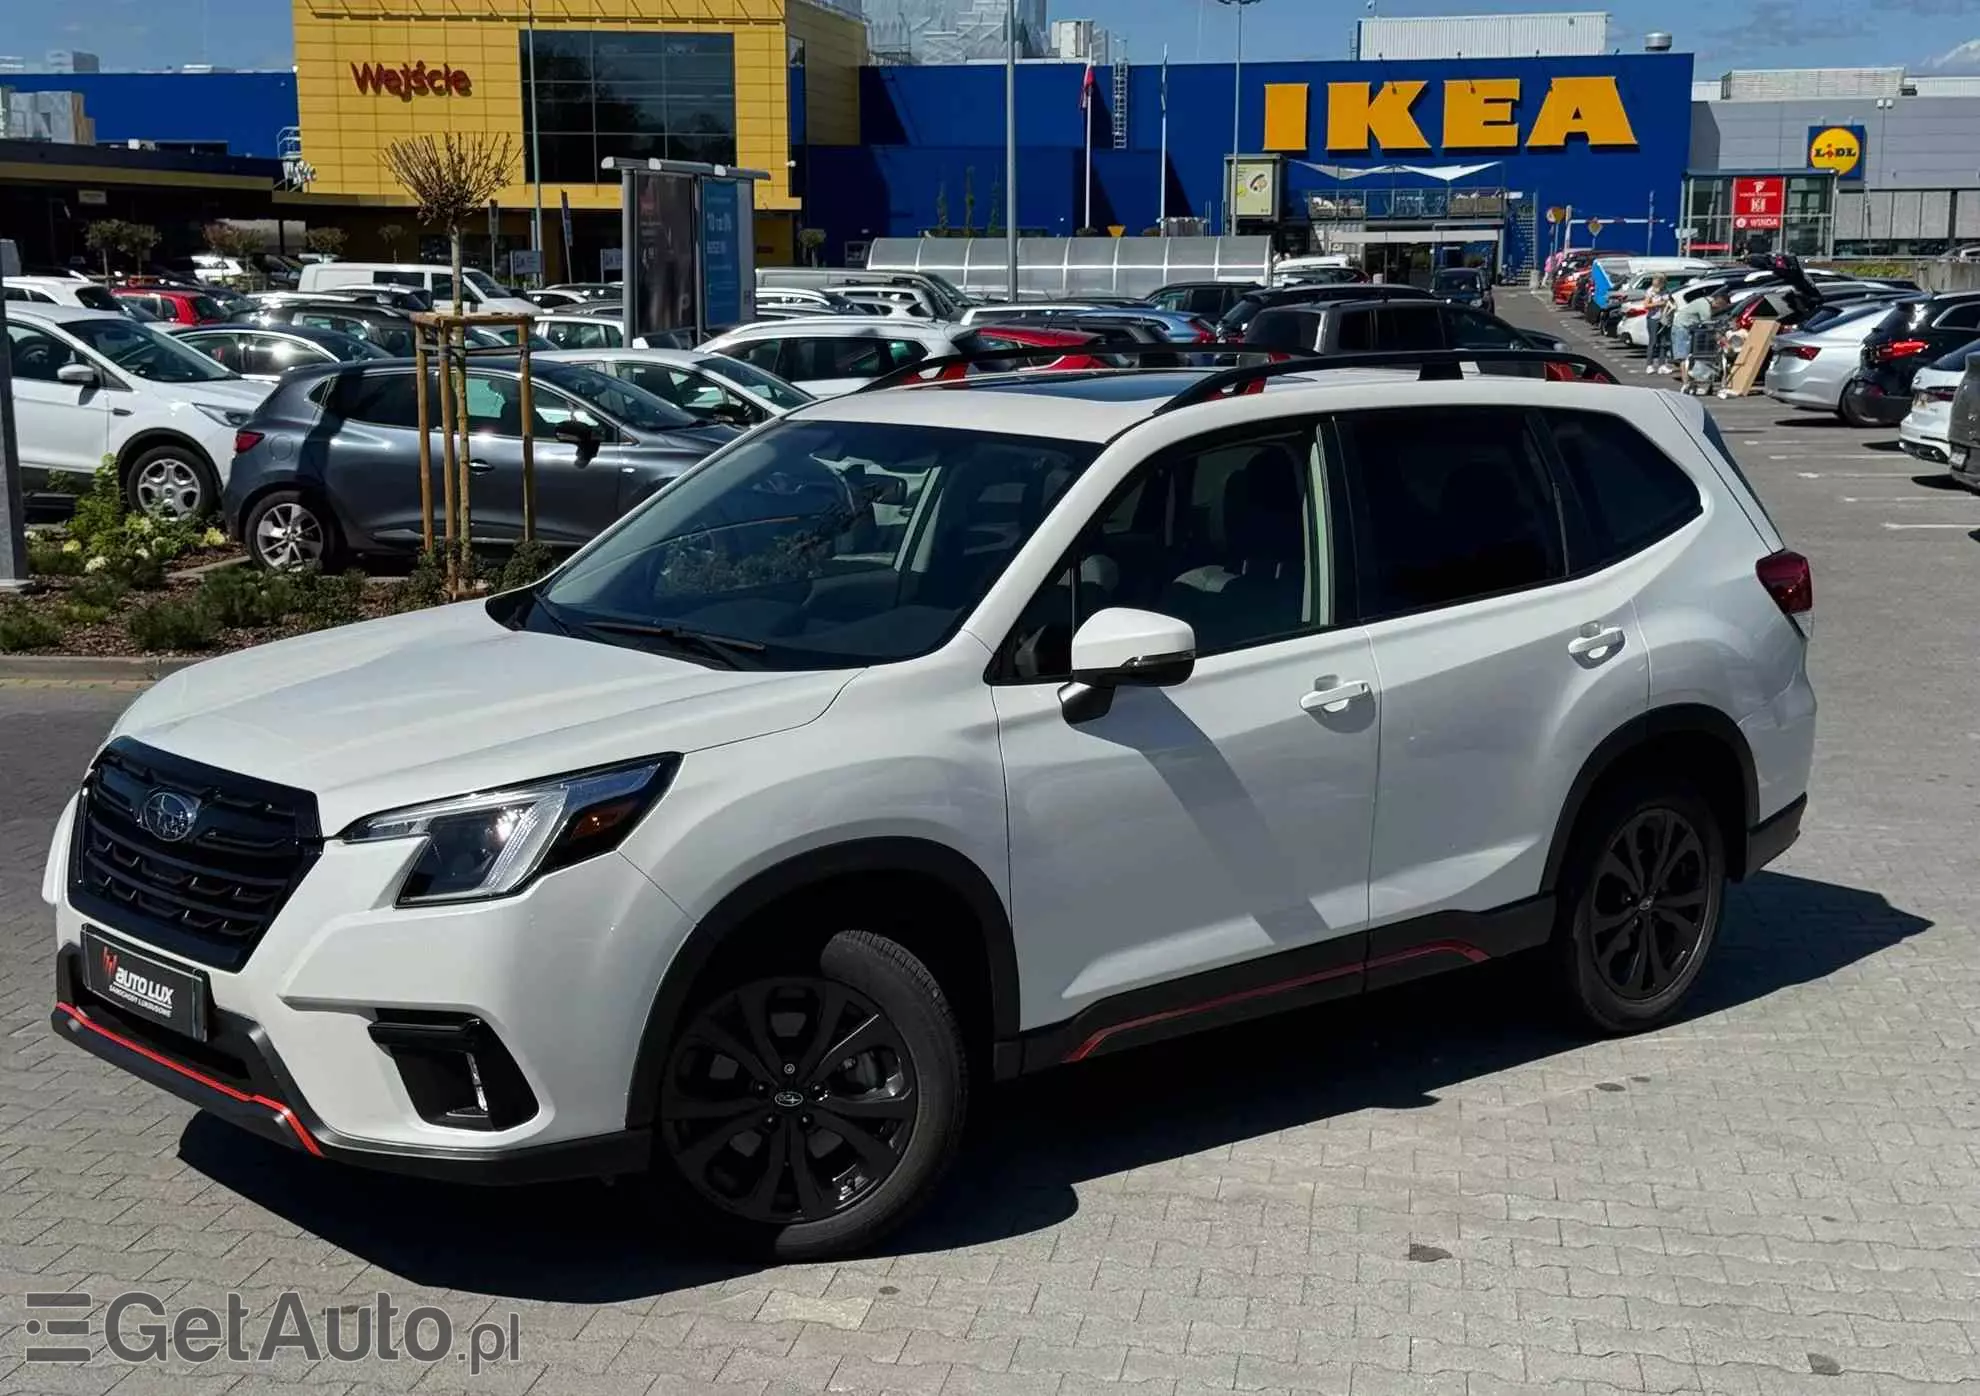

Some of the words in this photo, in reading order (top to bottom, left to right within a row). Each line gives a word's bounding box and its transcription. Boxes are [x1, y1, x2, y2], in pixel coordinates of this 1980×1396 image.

[350, 60, 472, 103] Wejście
[1262, 76, 1638, 150] IKEA
[148, 980, 174, 1005] LUX
